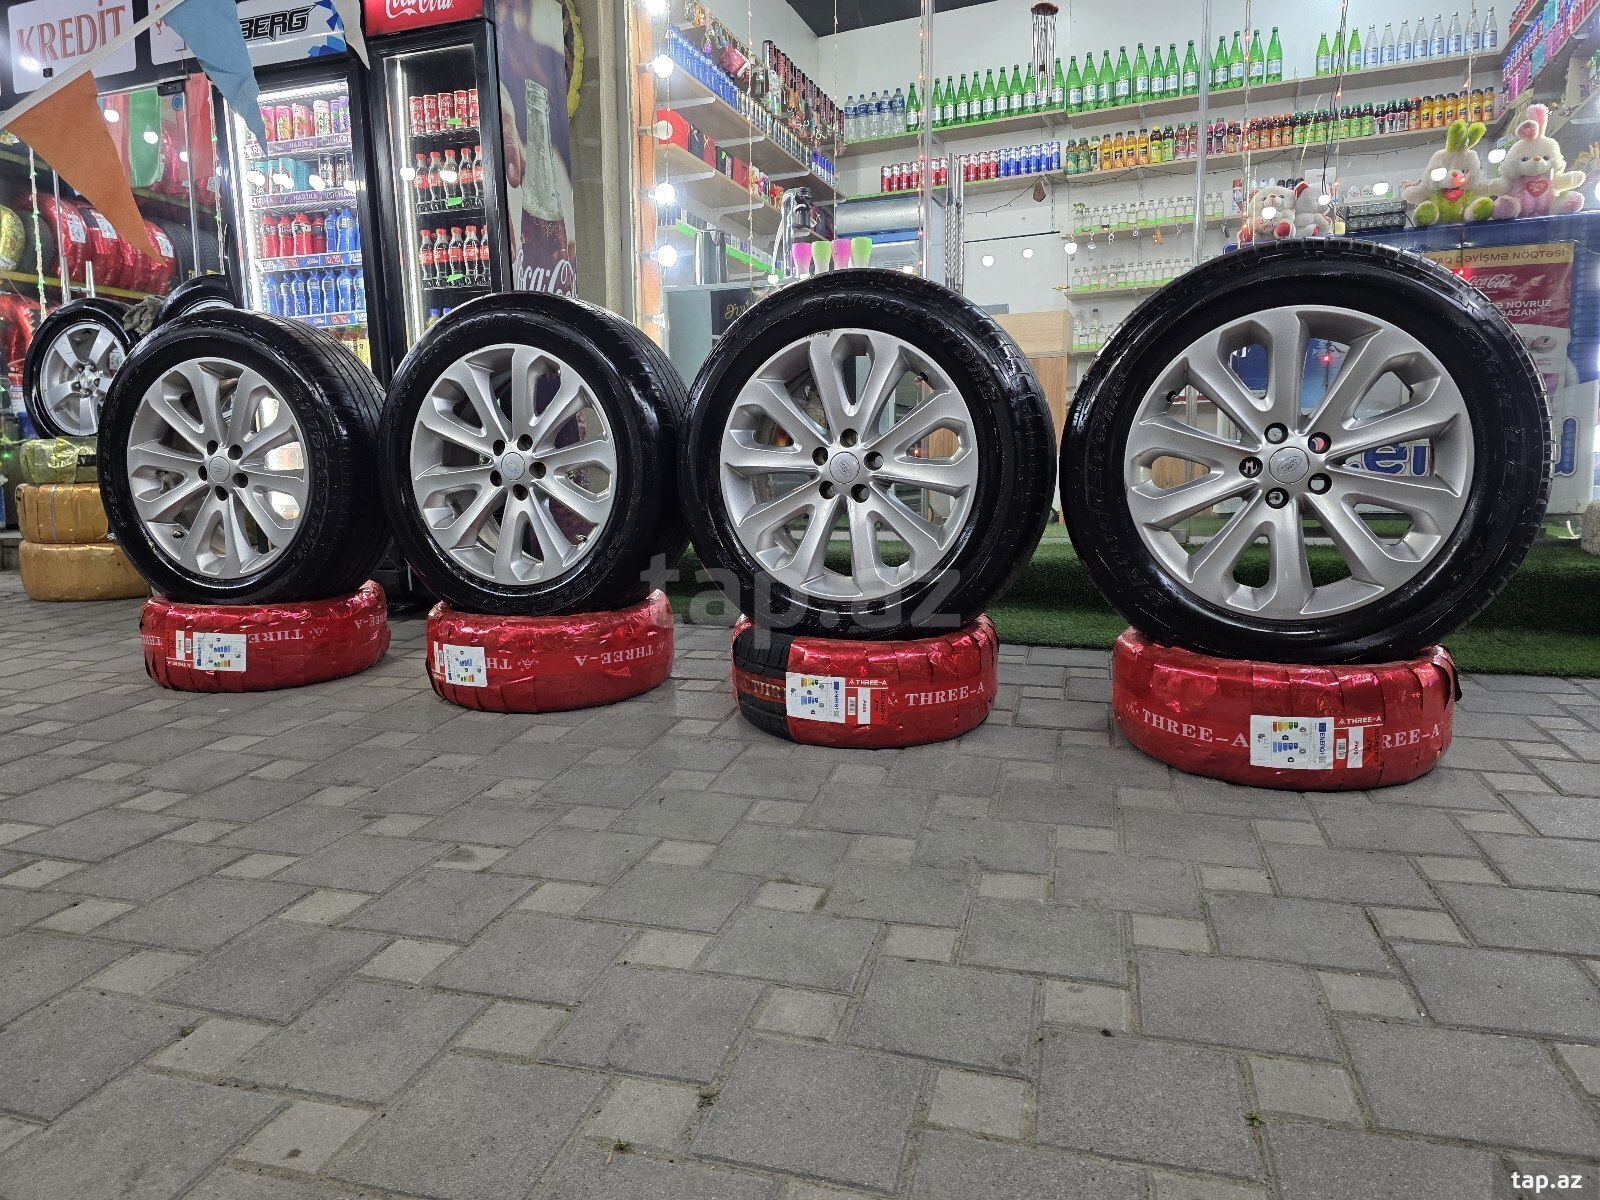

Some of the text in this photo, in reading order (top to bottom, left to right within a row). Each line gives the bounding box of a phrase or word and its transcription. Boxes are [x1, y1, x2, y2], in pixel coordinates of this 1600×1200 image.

[16, 0, 126, 62] KREDİT
[1456, 252, 1510, 263] DƏYİŞMƏ
[1512, 248, 1565, 259] NÖQTƏSİ
[1506, 299, 1552, 309] NOVRUZ
[574, 641, 655, 667] THREE-A
[905, 681, 986, 707] THREE-A
[1142, 709, 1250, 748] THREE-A
[1346, 716, 1382, 725] THREE-A
